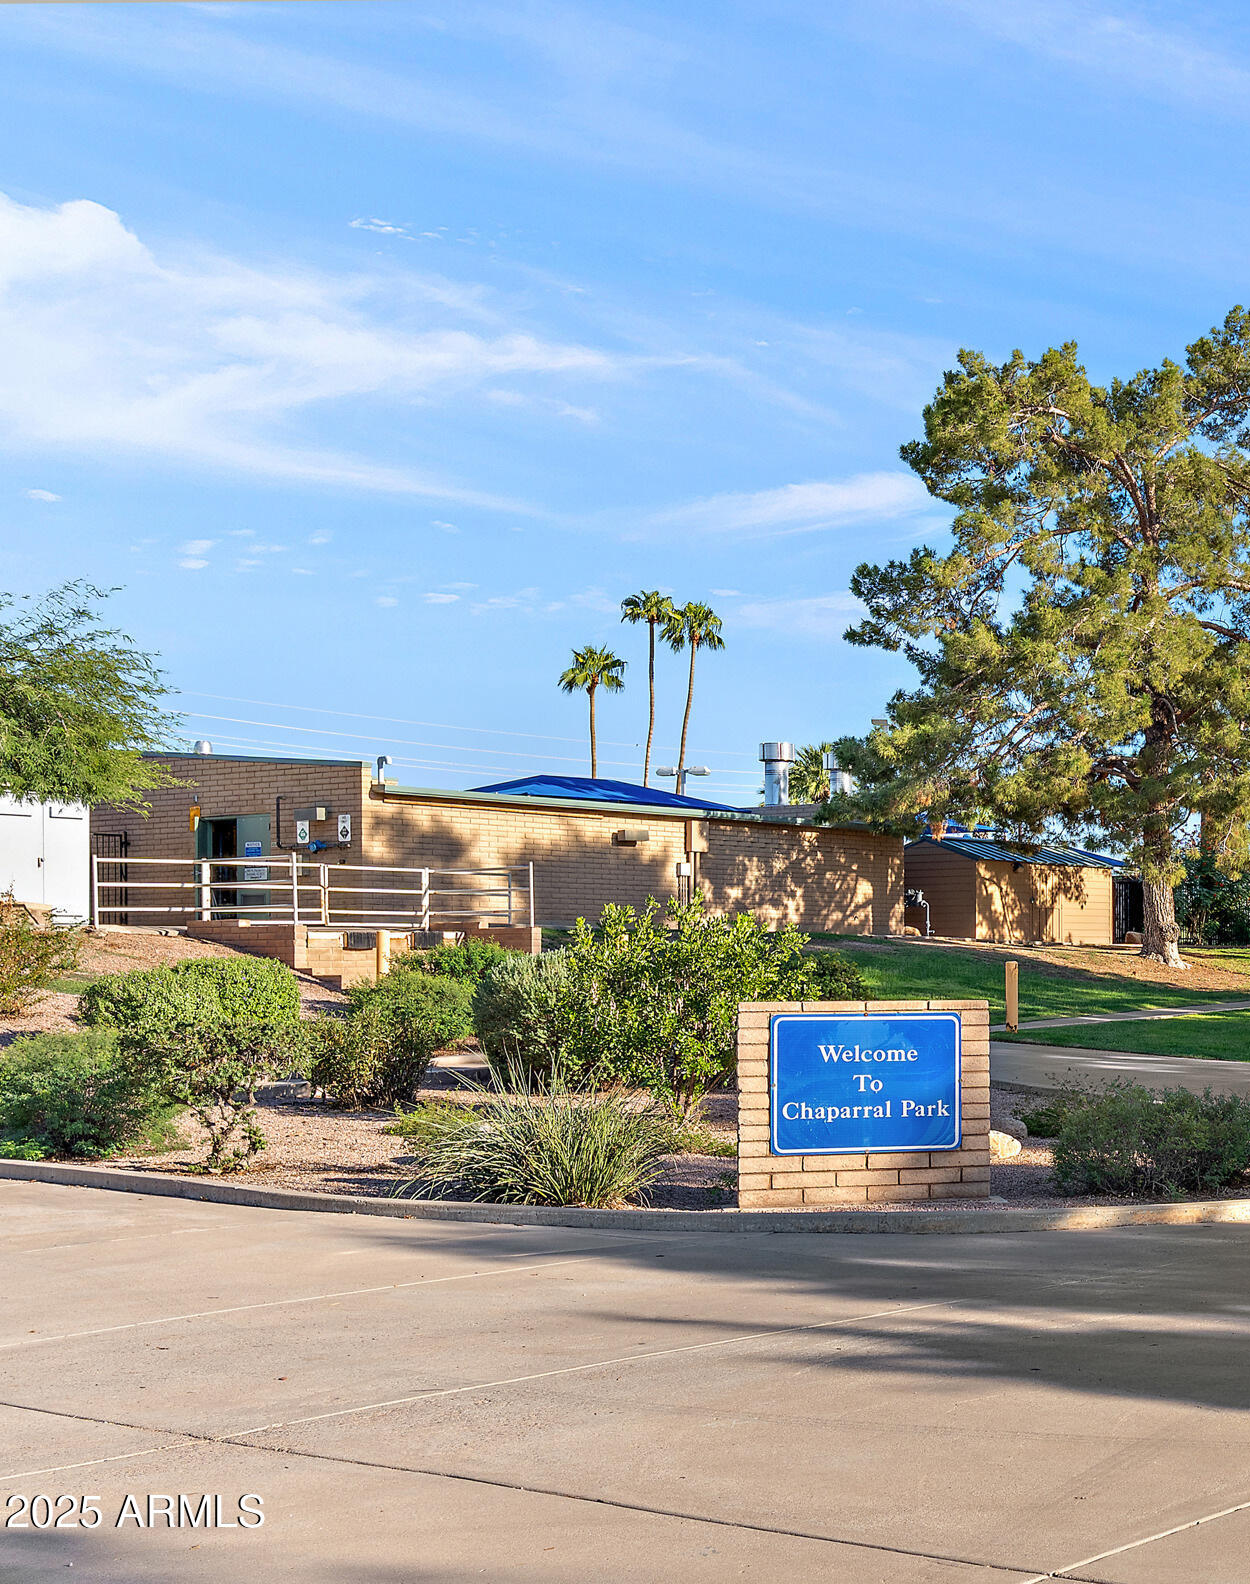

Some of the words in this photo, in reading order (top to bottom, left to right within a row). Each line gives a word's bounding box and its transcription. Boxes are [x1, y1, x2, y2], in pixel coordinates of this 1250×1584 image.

[818, 1045, 918, 1063] Welcome
[852, 1074, 884, 1092] To
[782, 1100, 891, 1123] Chaparral
[901, 1099, 950, 1118] Park
